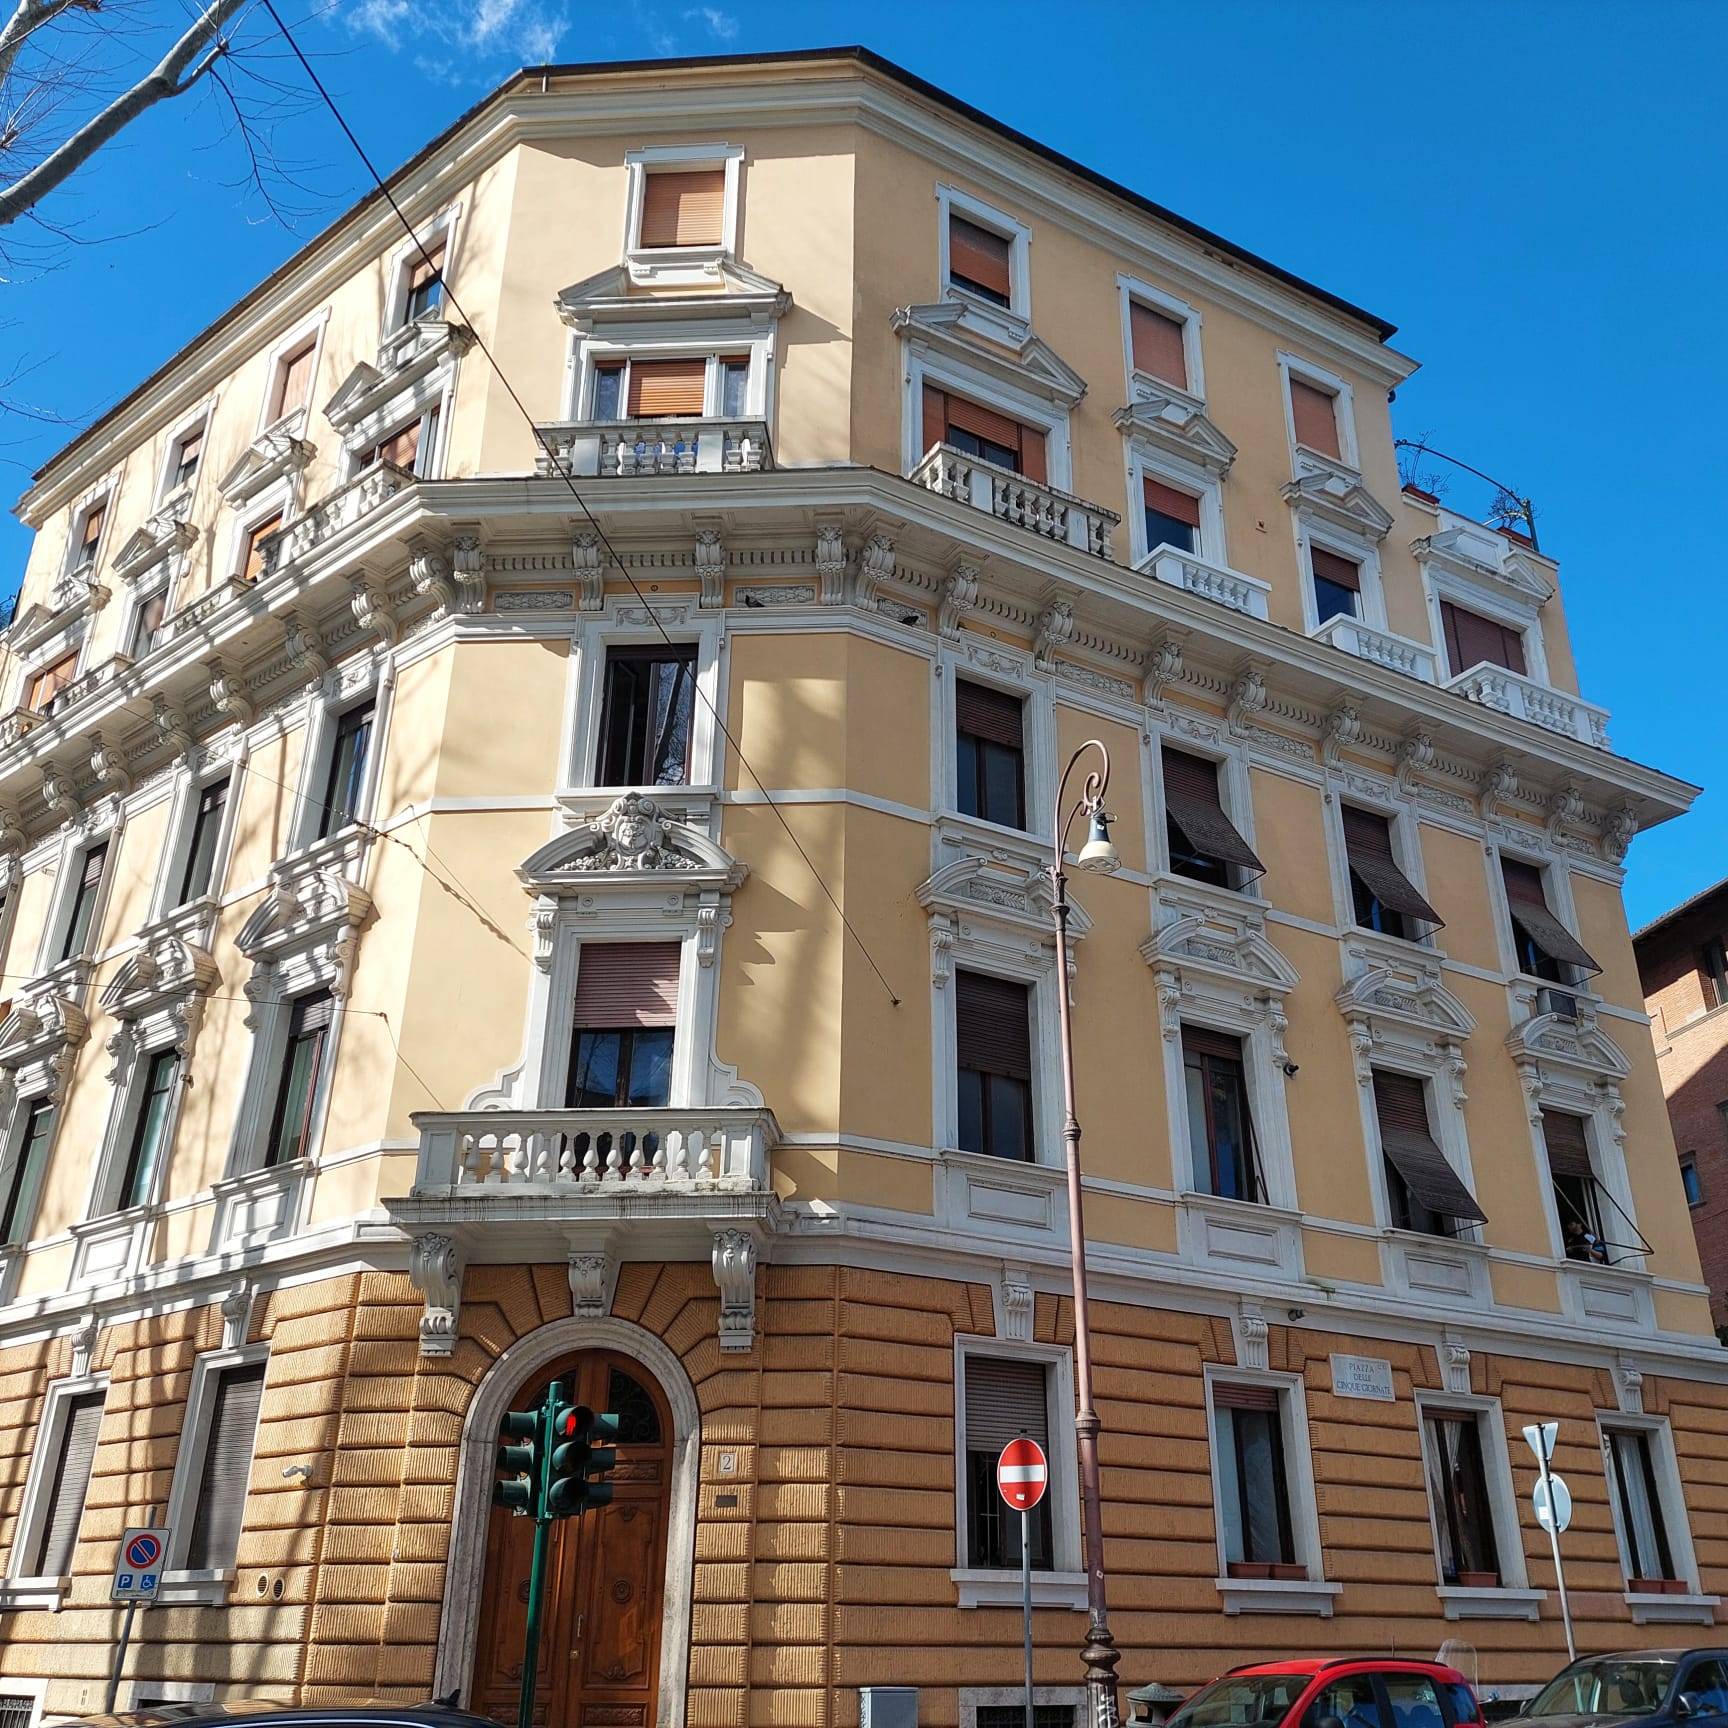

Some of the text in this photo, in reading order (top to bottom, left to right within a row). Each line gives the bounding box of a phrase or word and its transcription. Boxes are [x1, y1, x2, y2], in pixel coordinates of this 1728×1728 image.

[1349, 1362, 1375, 1374] PIAZZA
[1353, 1373, 1371, 1381] DELLE
[1336, 1380, 1393, 1394] CINQUE GIORNATE
[722, 1455, 732, 1470] 2
[120, 1575, 130, 1587] P
